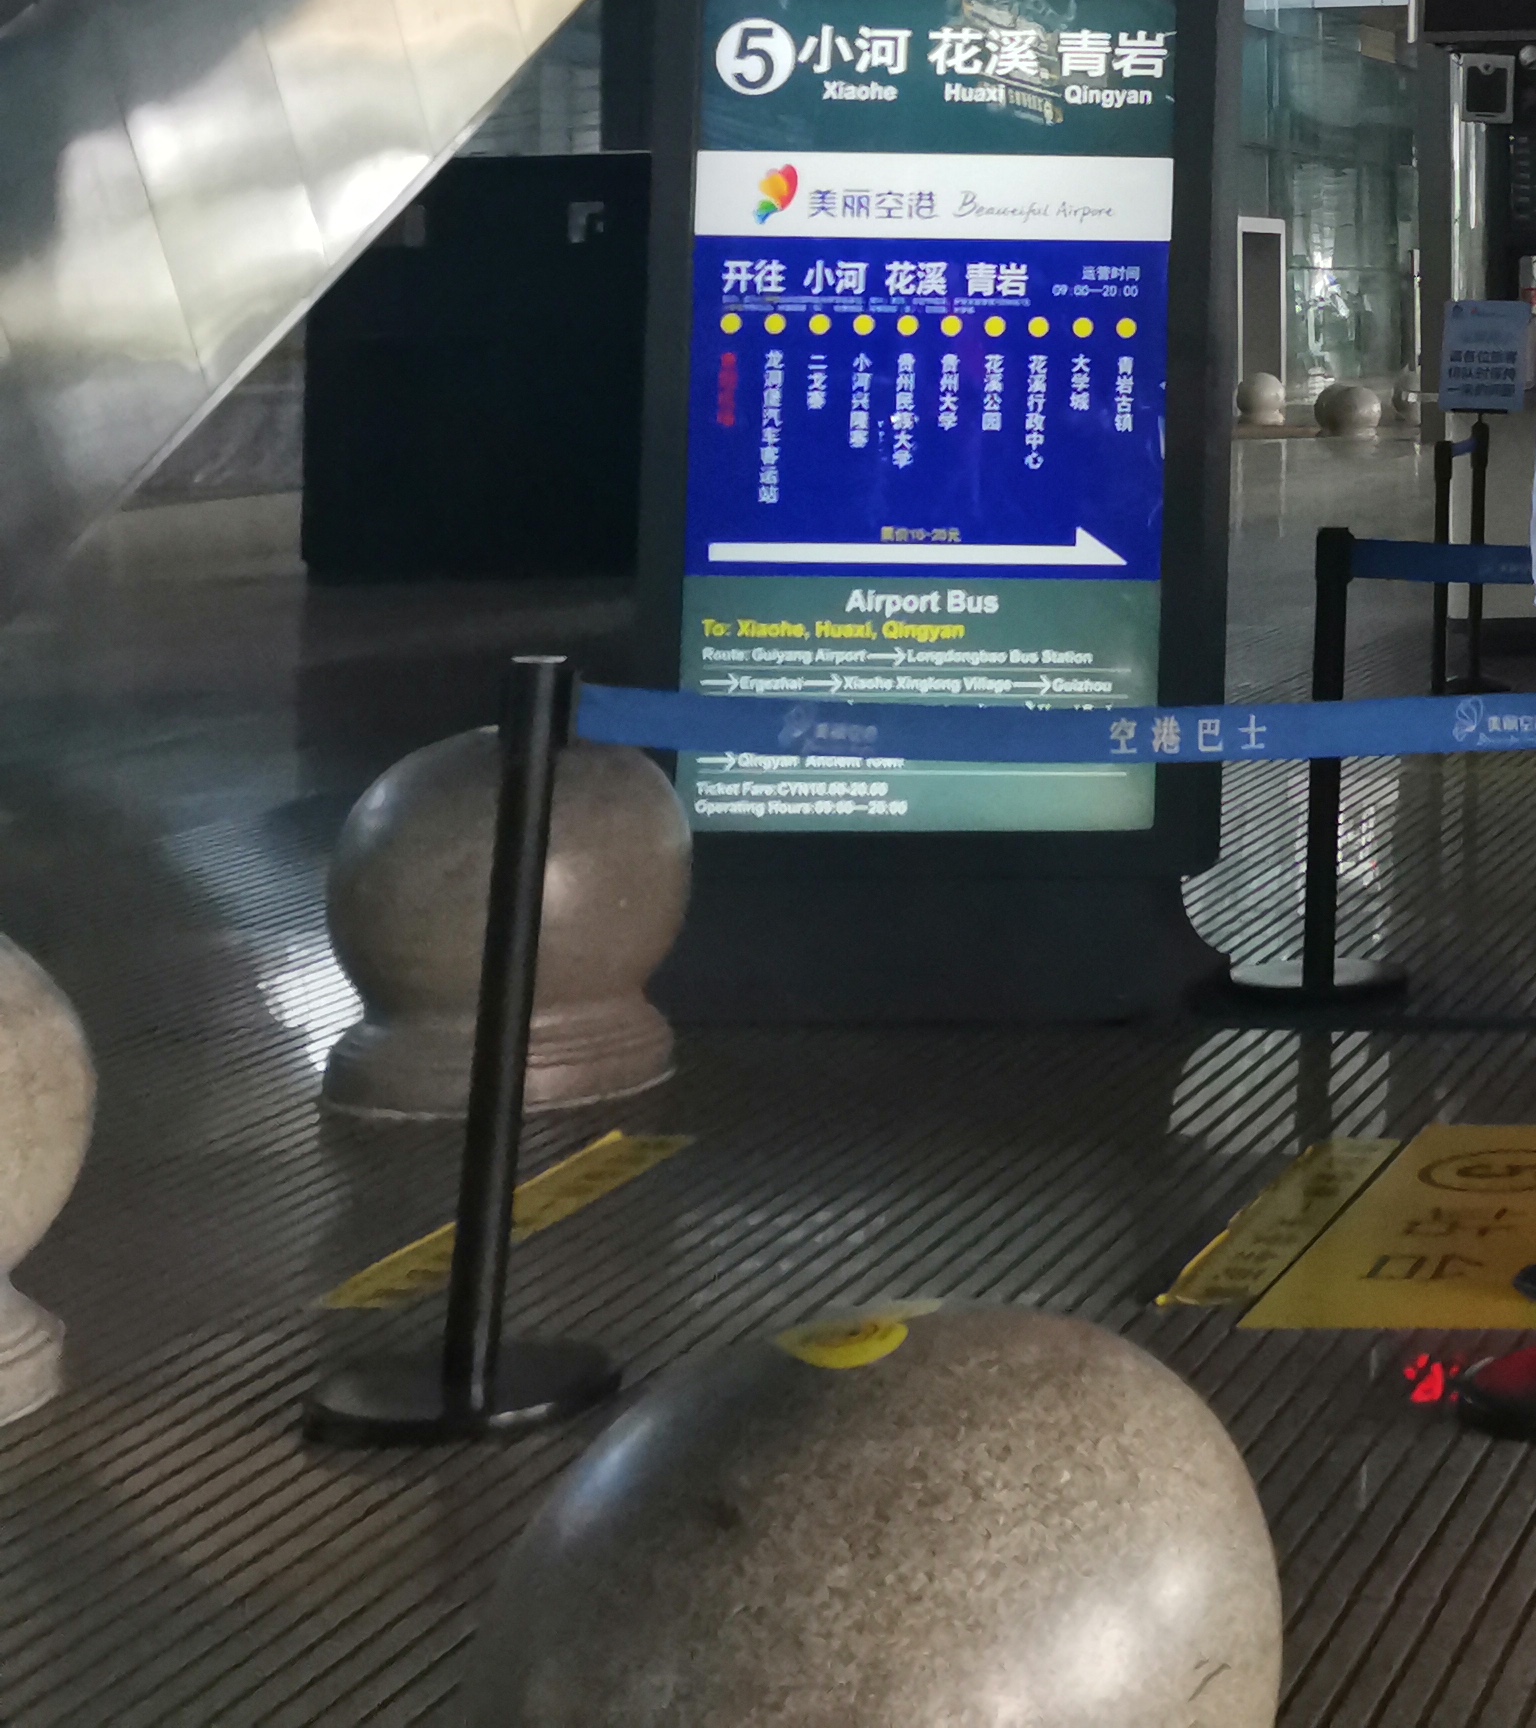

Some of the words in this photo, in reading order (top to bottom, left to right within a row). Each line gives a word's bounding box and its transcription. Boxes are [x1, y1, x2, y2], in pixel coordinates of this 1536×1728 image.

[798, 25, 912, 74] 小河
[928, 28, 1041, 76] 花溪
[1057, 30, 1168, 79] 青岩
[823, 81, 898, 101] Xiaohe
[944, 83, 1005, 103] Huaxi
[1065, 85, 1152, 108] Qingyan
[808, 189, 938, 220] 美丽空港
[721, 259, 787, 294] 开往
[803, 260, 869, 295] 小河
[885, 261, 948, 295] 花溪
[966, 262, 1029, 297] 青岩
[1081, 266, 1140, 281] 运营时间
[937, 353, 960, 431] 贵州大学
[982, 354, 1004, 431] 花溪公园
[1070, 353, 1090, 411] 大学城
[1114, 356, 1134, 432] 青岩古镇
[1024, 354, 1048, 470] 花溪行政中心
[845, 589, 941, 618] Airport
[947, 589, 999, 613] Bus
[881, 620, 965, 643] Qingyan
[751, 647, 814, 665] Guiyang
[814, 648, 867, 665] Airport
[1009, 649, 1040, 664] Bus
[1041, 649, 1094, 664] Station
[1109, 714, 1267, 755] 空港巴士
